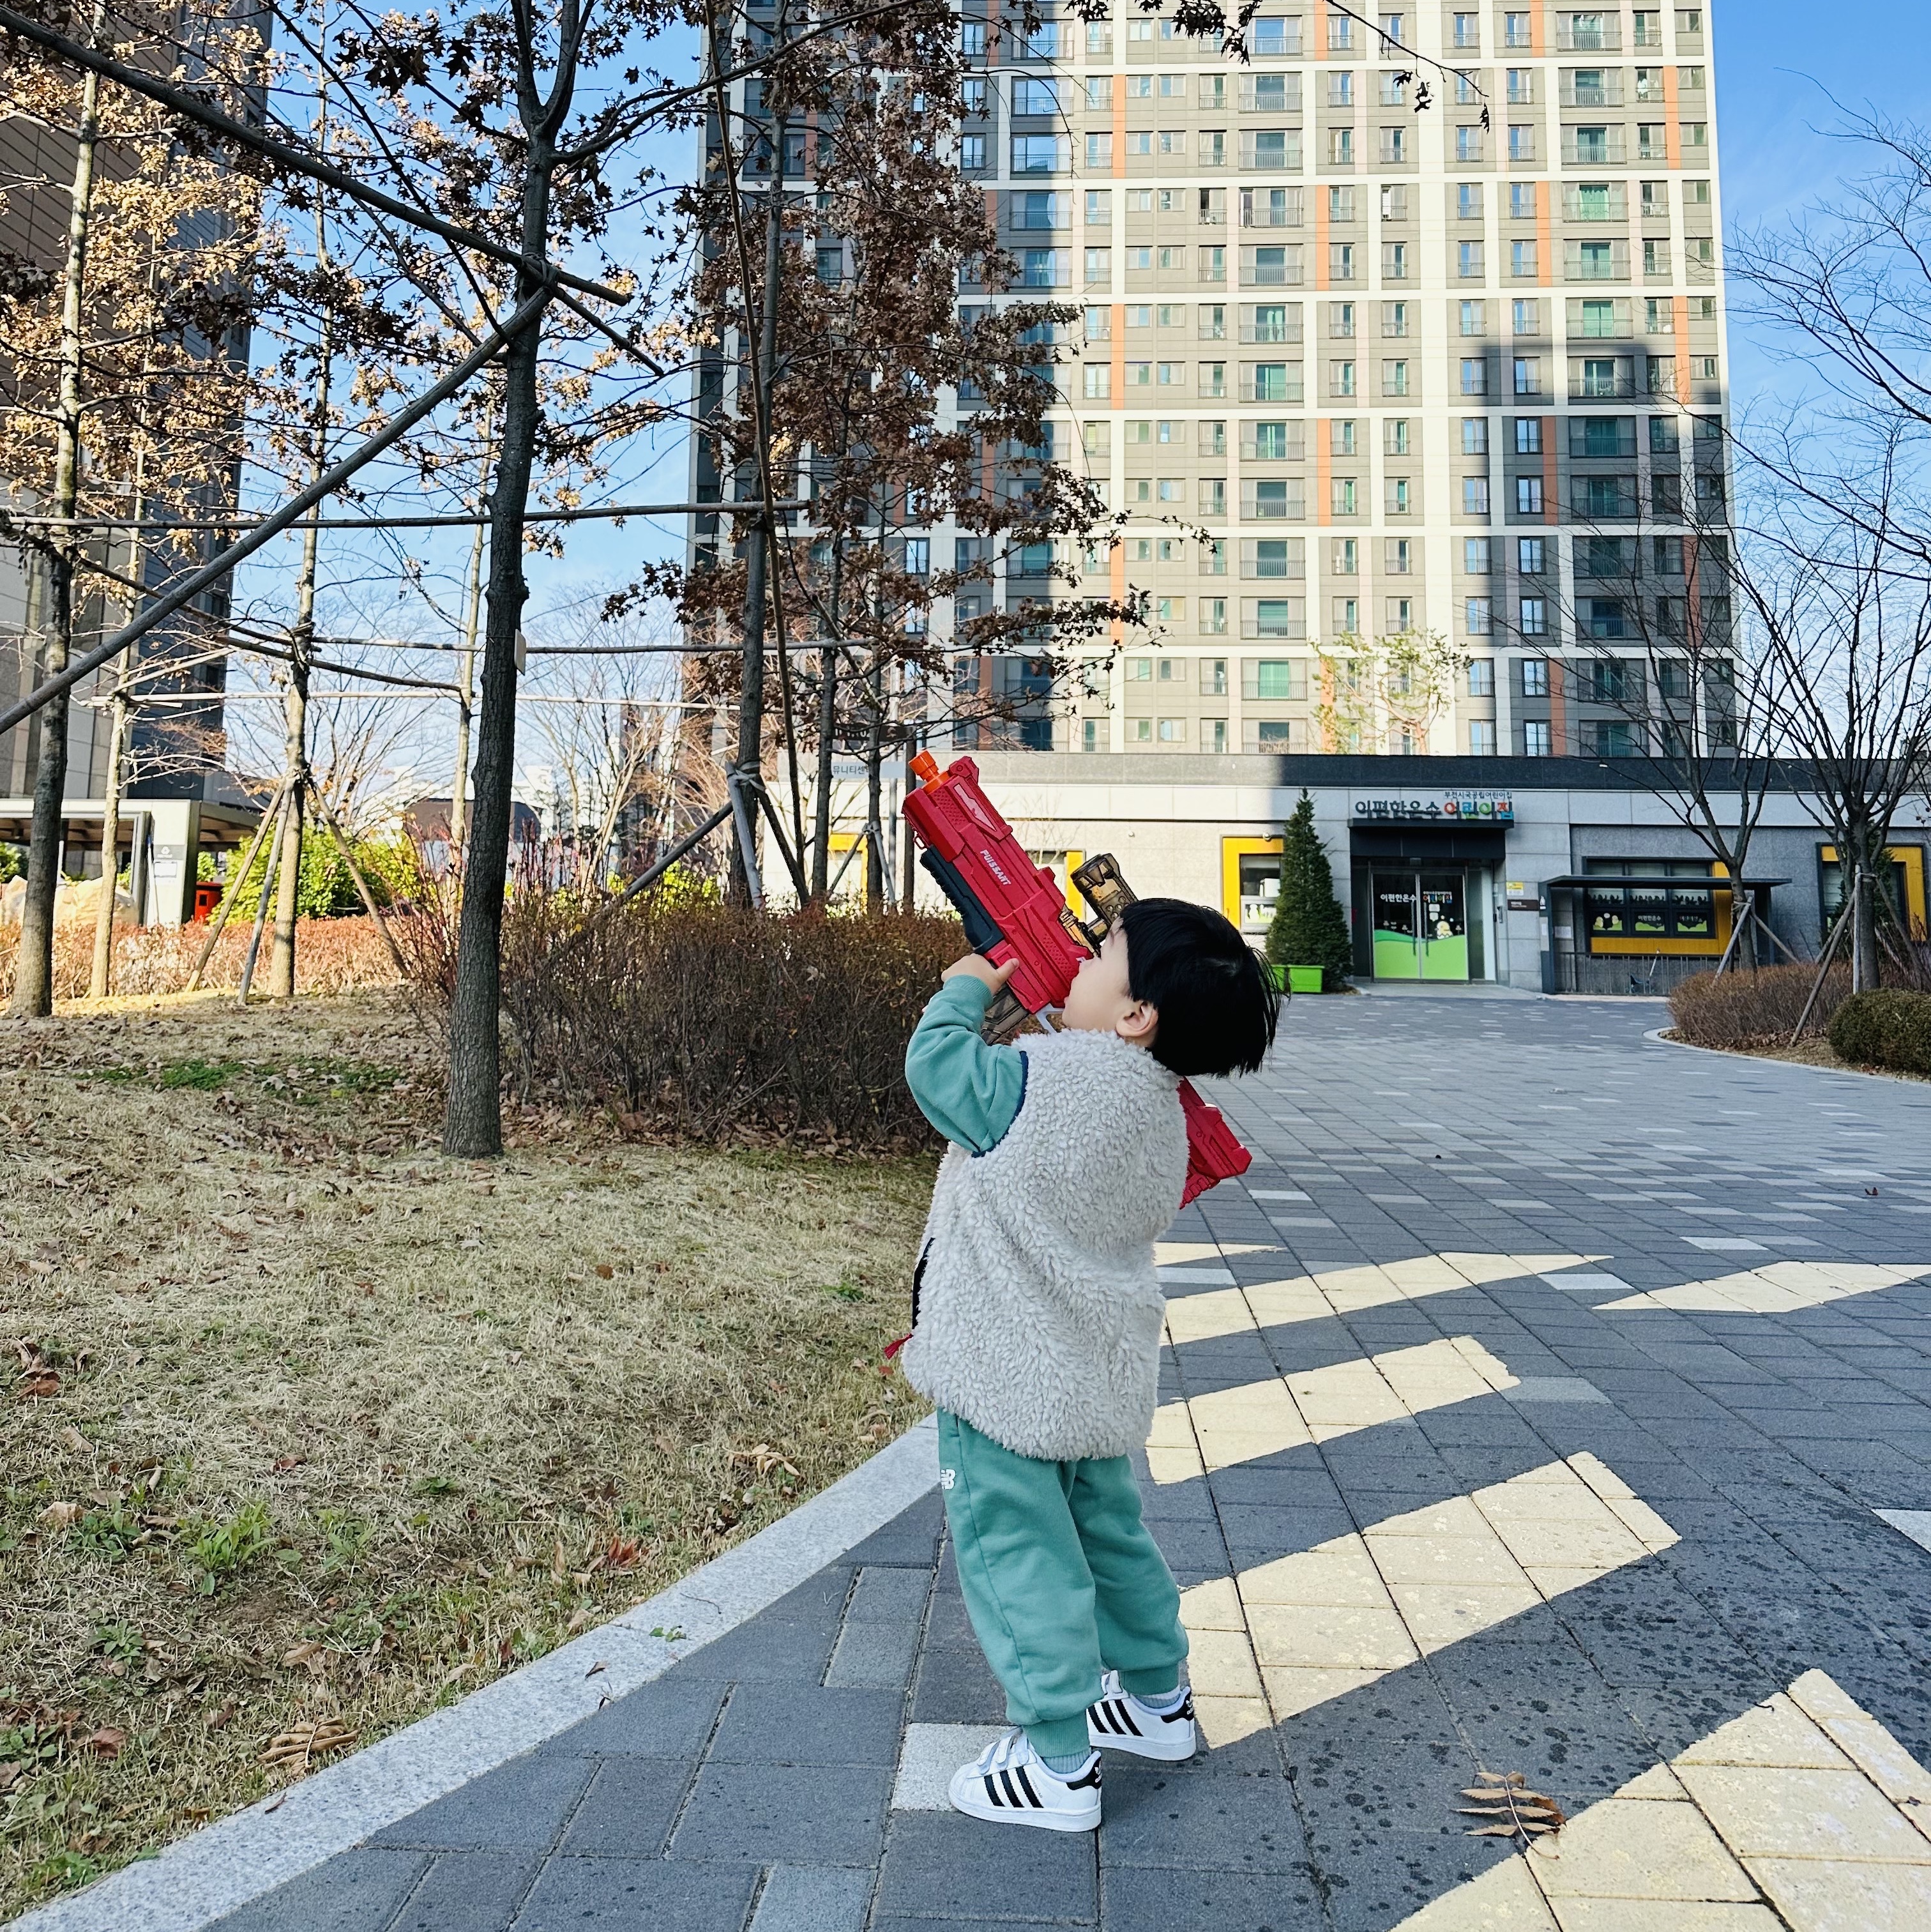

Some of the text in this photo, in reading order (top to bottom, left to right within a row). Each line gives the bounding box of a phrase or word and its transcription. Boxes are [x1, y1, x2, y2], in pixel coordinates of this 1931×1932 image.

[833, 765, 869, 775] 뮤니티센
[1355, 800, 1514, 820] 이편한온수 어린이집
[980, 849, 1011, 885] PUISSANT
